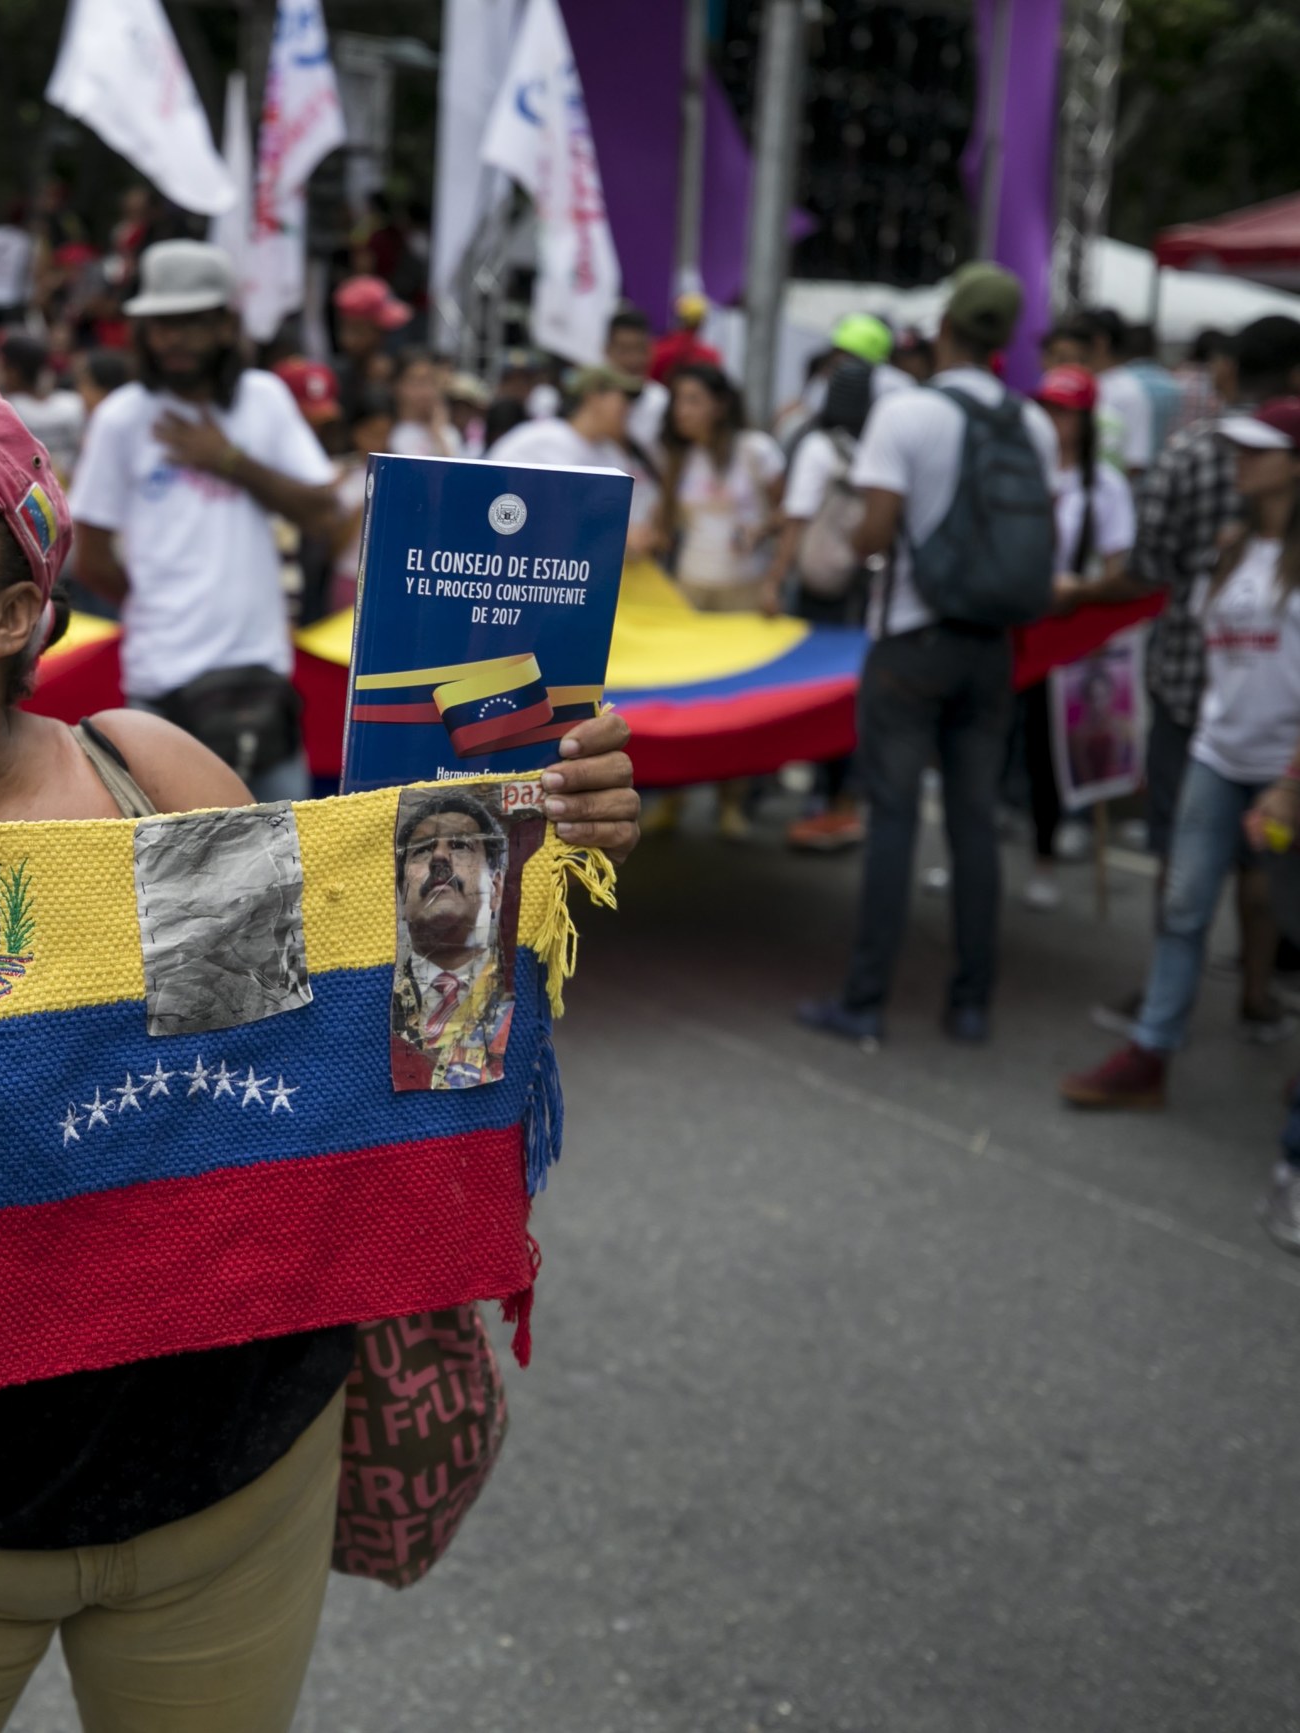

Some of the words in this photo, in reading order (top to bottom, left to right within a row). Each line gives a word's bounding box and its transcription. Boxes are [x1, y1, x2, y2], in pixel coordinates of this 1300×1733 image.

[406, 548, 426, 572] EL
[430, 550, 503, 577] CONSEJO
[507, 555, 529, 579] DE
[532, 557, 590, 582] ESTADO
[405, 576, 415, 595] Y
[417, 577, 432, 596] EL
[435, 579, 493, 600] PROCESO
[495, 583, 588, 606] CONSTITUYENTE
[471, 606, 489, 624] DE
[491, 607, 522, 626] 2017
